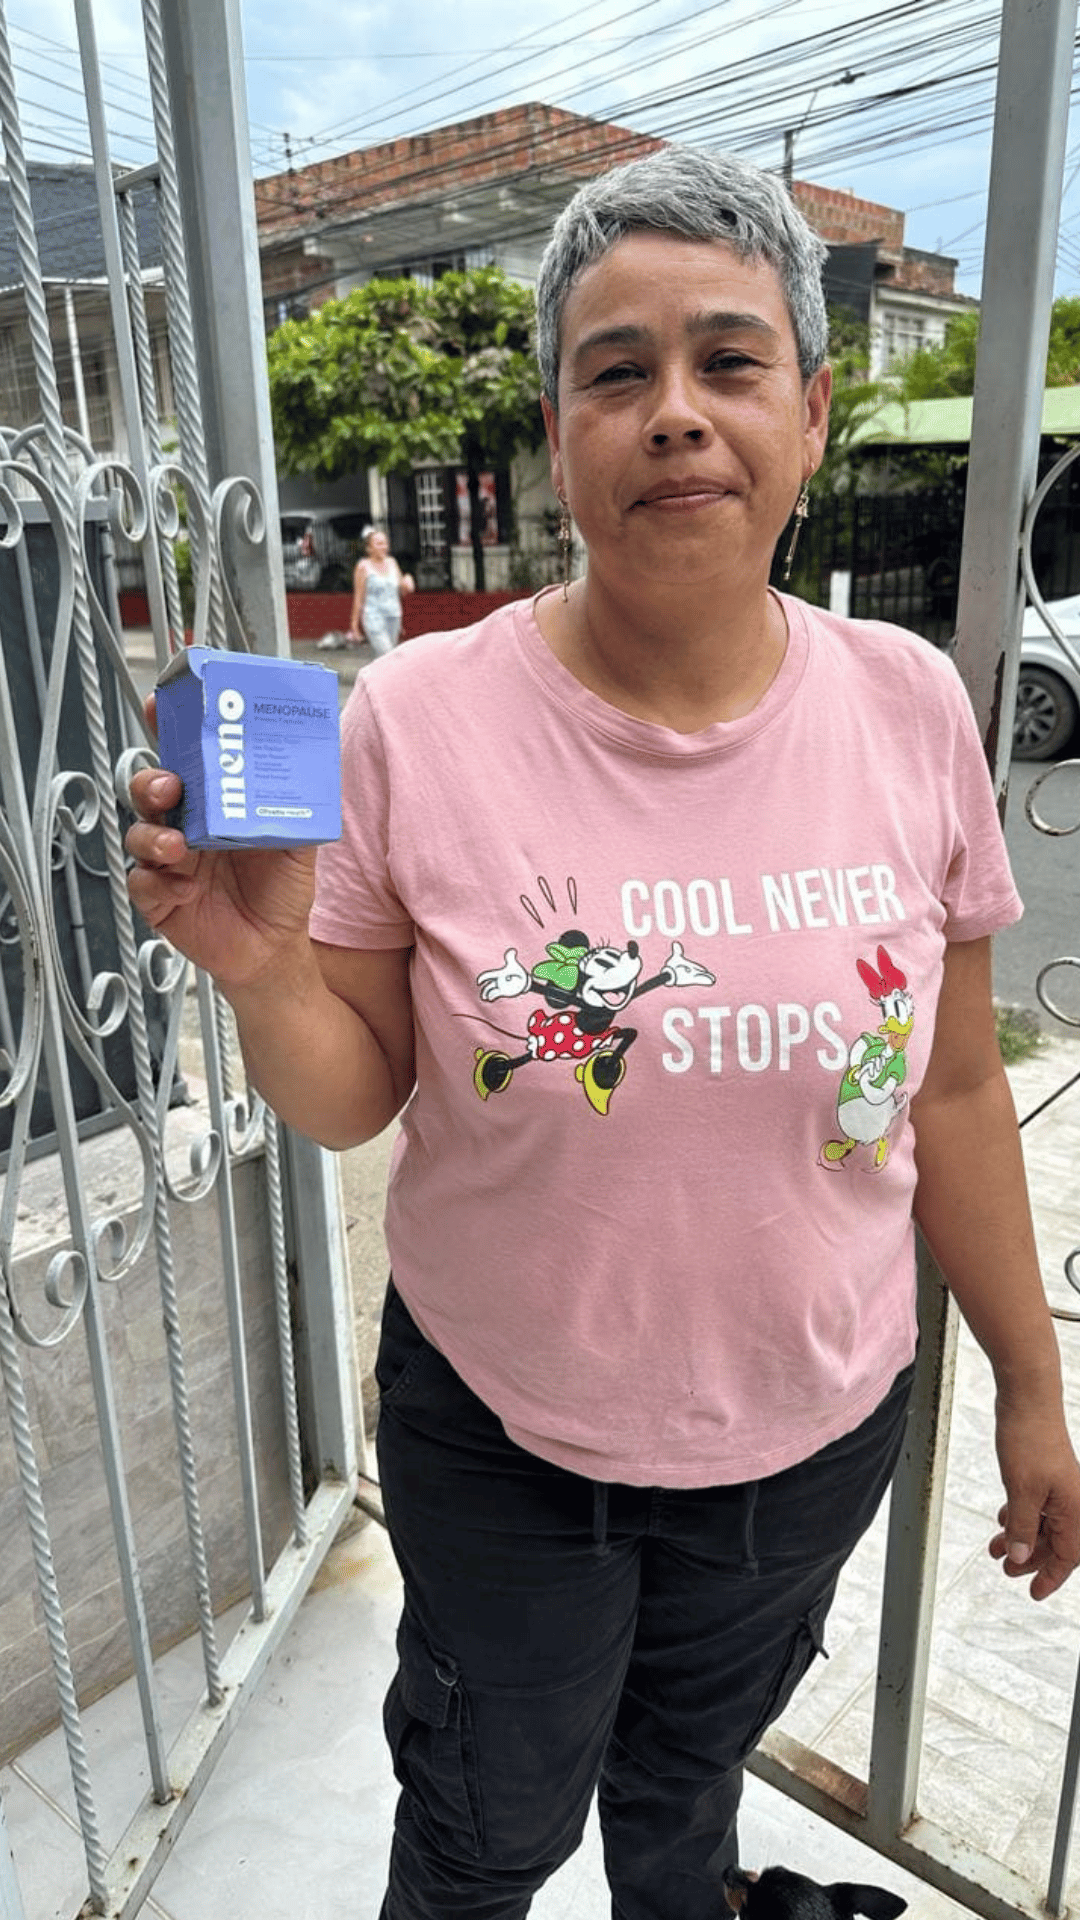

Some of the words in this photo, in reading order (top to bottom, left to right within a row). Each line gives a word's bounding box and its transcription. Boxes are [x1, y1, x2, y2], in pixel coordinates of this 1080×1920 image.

[253, 702, 331, 719] MENOPAUSE
[218, 688, 247, 820] meno
[620, 879, 752, 937] COOL
[762, 864, 906, 931] NEVER
[662, 1003, 849, 1074] STOPS
